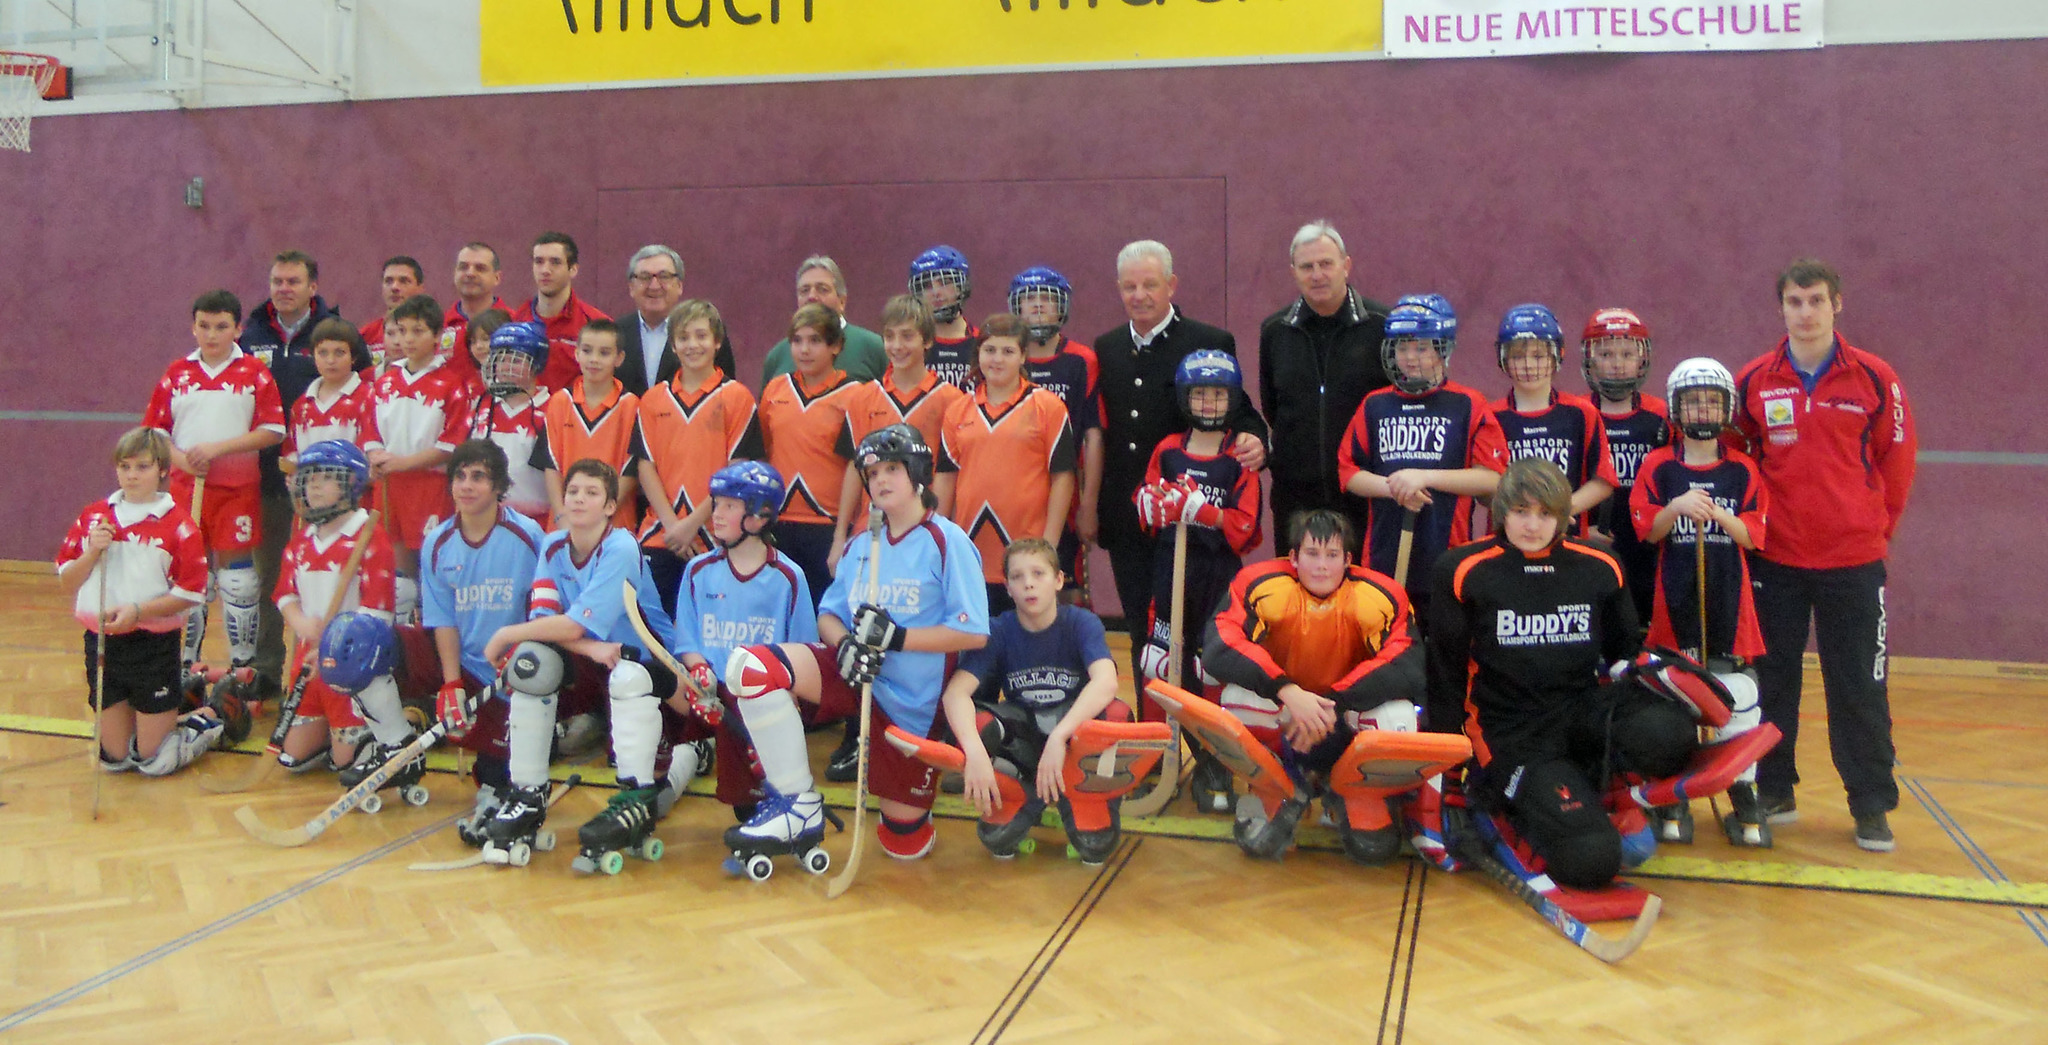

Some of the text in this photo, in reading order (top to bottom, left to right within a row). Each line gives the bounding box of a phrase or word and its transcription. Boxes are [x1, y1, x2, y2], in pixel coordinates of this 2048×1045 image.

[1404, 3, 1800, 43] NEUE MITTELSCHULE
[1379, 425, 1446, 453] BUDDY'S
[1508, 438, 1570, 449] EAMSPORT
[235, 515, 252, 542] 3
[1524, 565, 1555, 573] macron
[1557, 604, 1591, 613] SPORTS
[702, 613, 775, 645] BUDDY'S
[1497, 609, 1590, 636] BUDDY'S
[921, 767, 934, 789] 5
